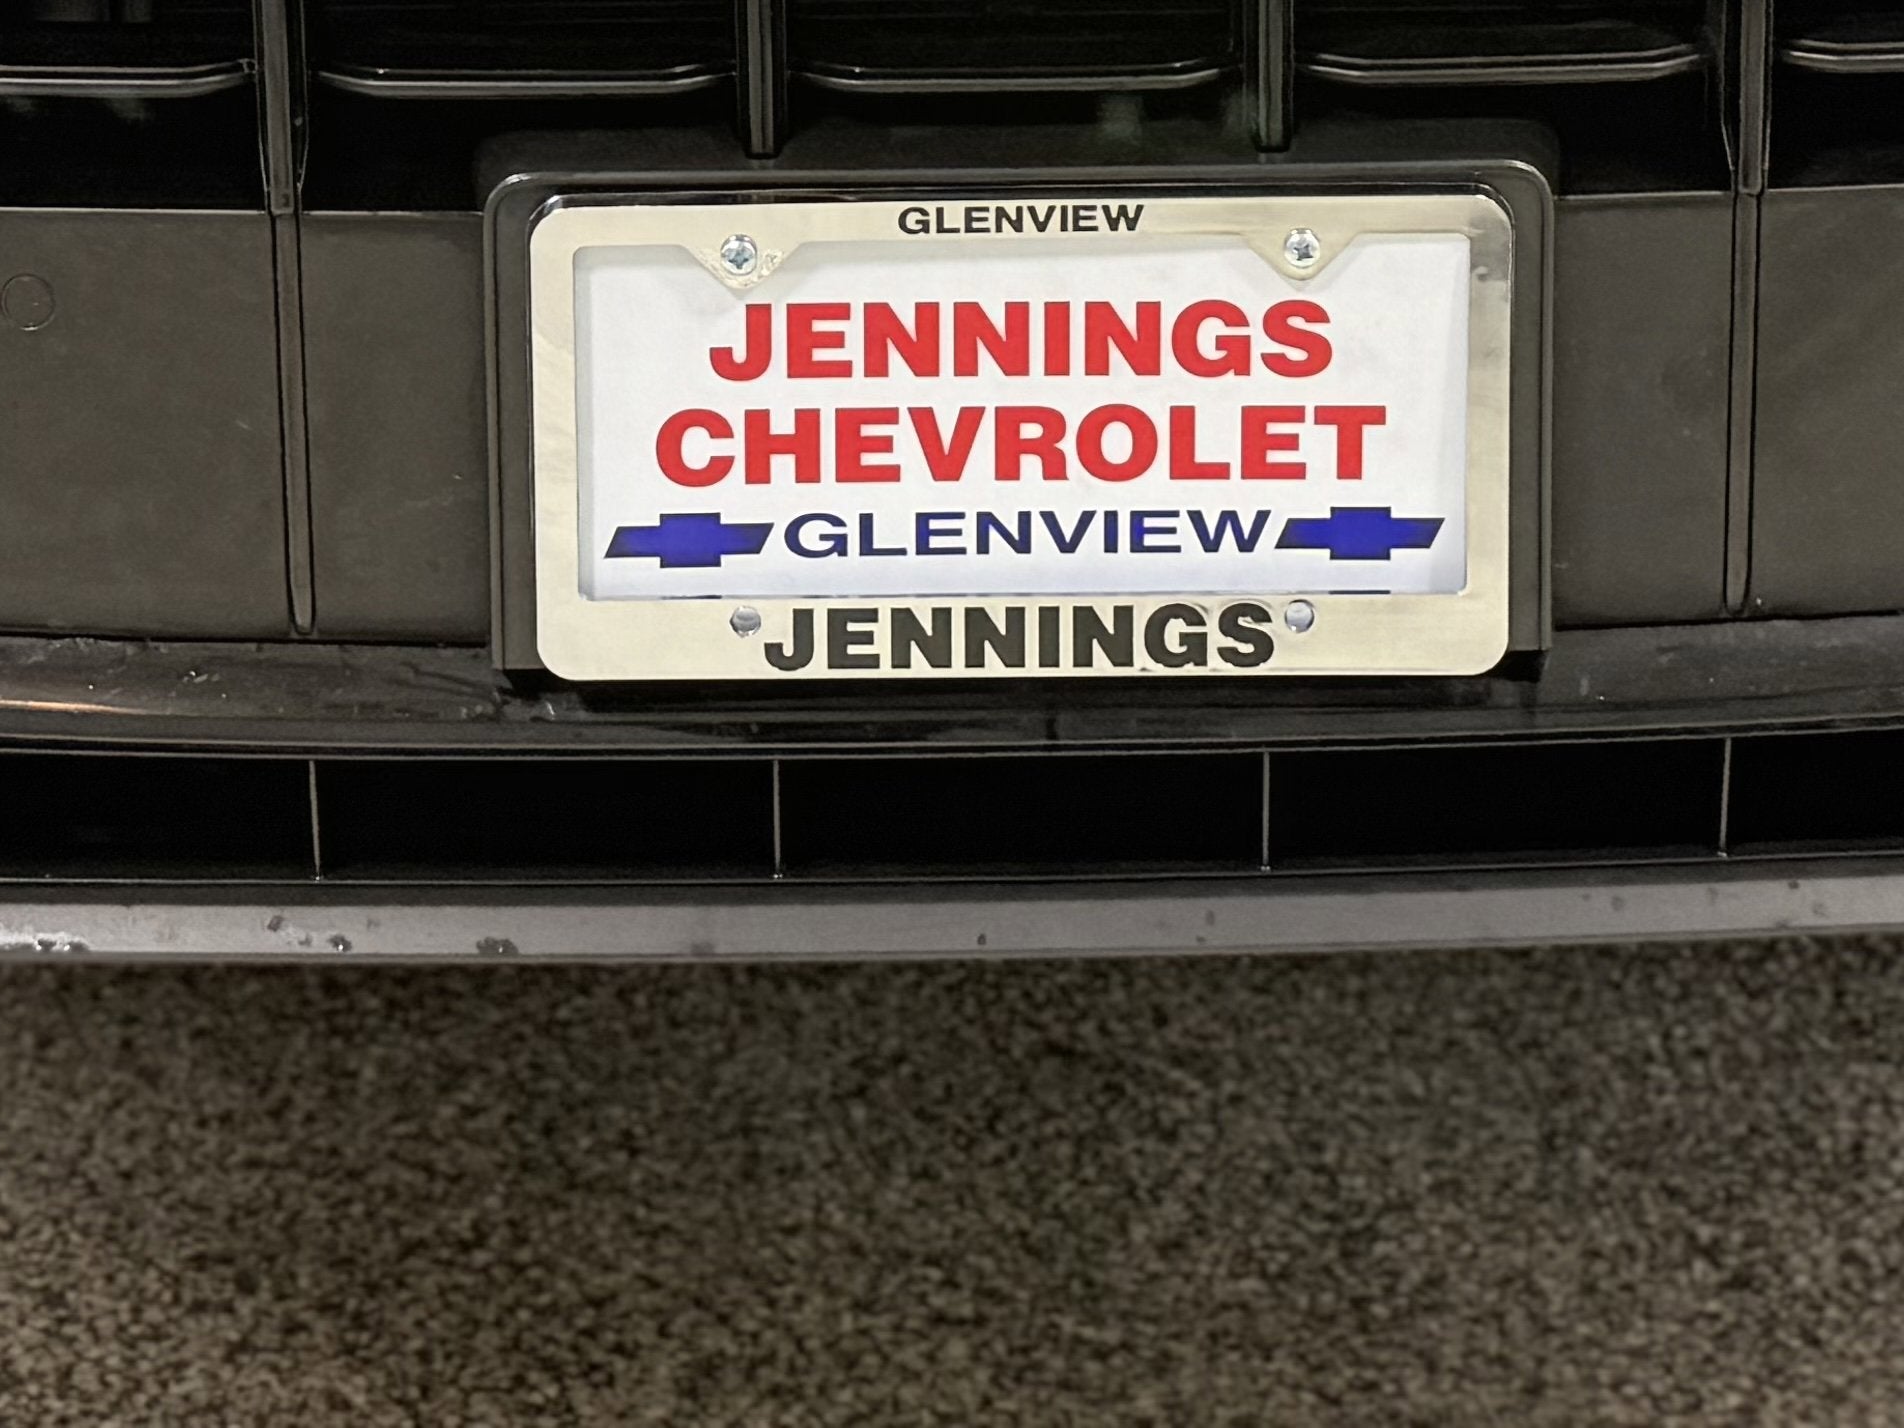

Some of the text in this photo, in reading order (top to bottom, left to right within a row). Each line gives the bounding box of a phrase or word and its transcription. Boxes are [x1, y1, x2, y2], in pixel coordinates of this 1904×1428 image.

[897, 204, 1144, 235] GLENVIEW
[710, 300, 1333, 382] JENNINGS
[656, 404, 1386, 488] CHEVROLET
[783, 508, 1272, 559] GLENVIEW
[764, 602, 1275, 671] JENNINGS
